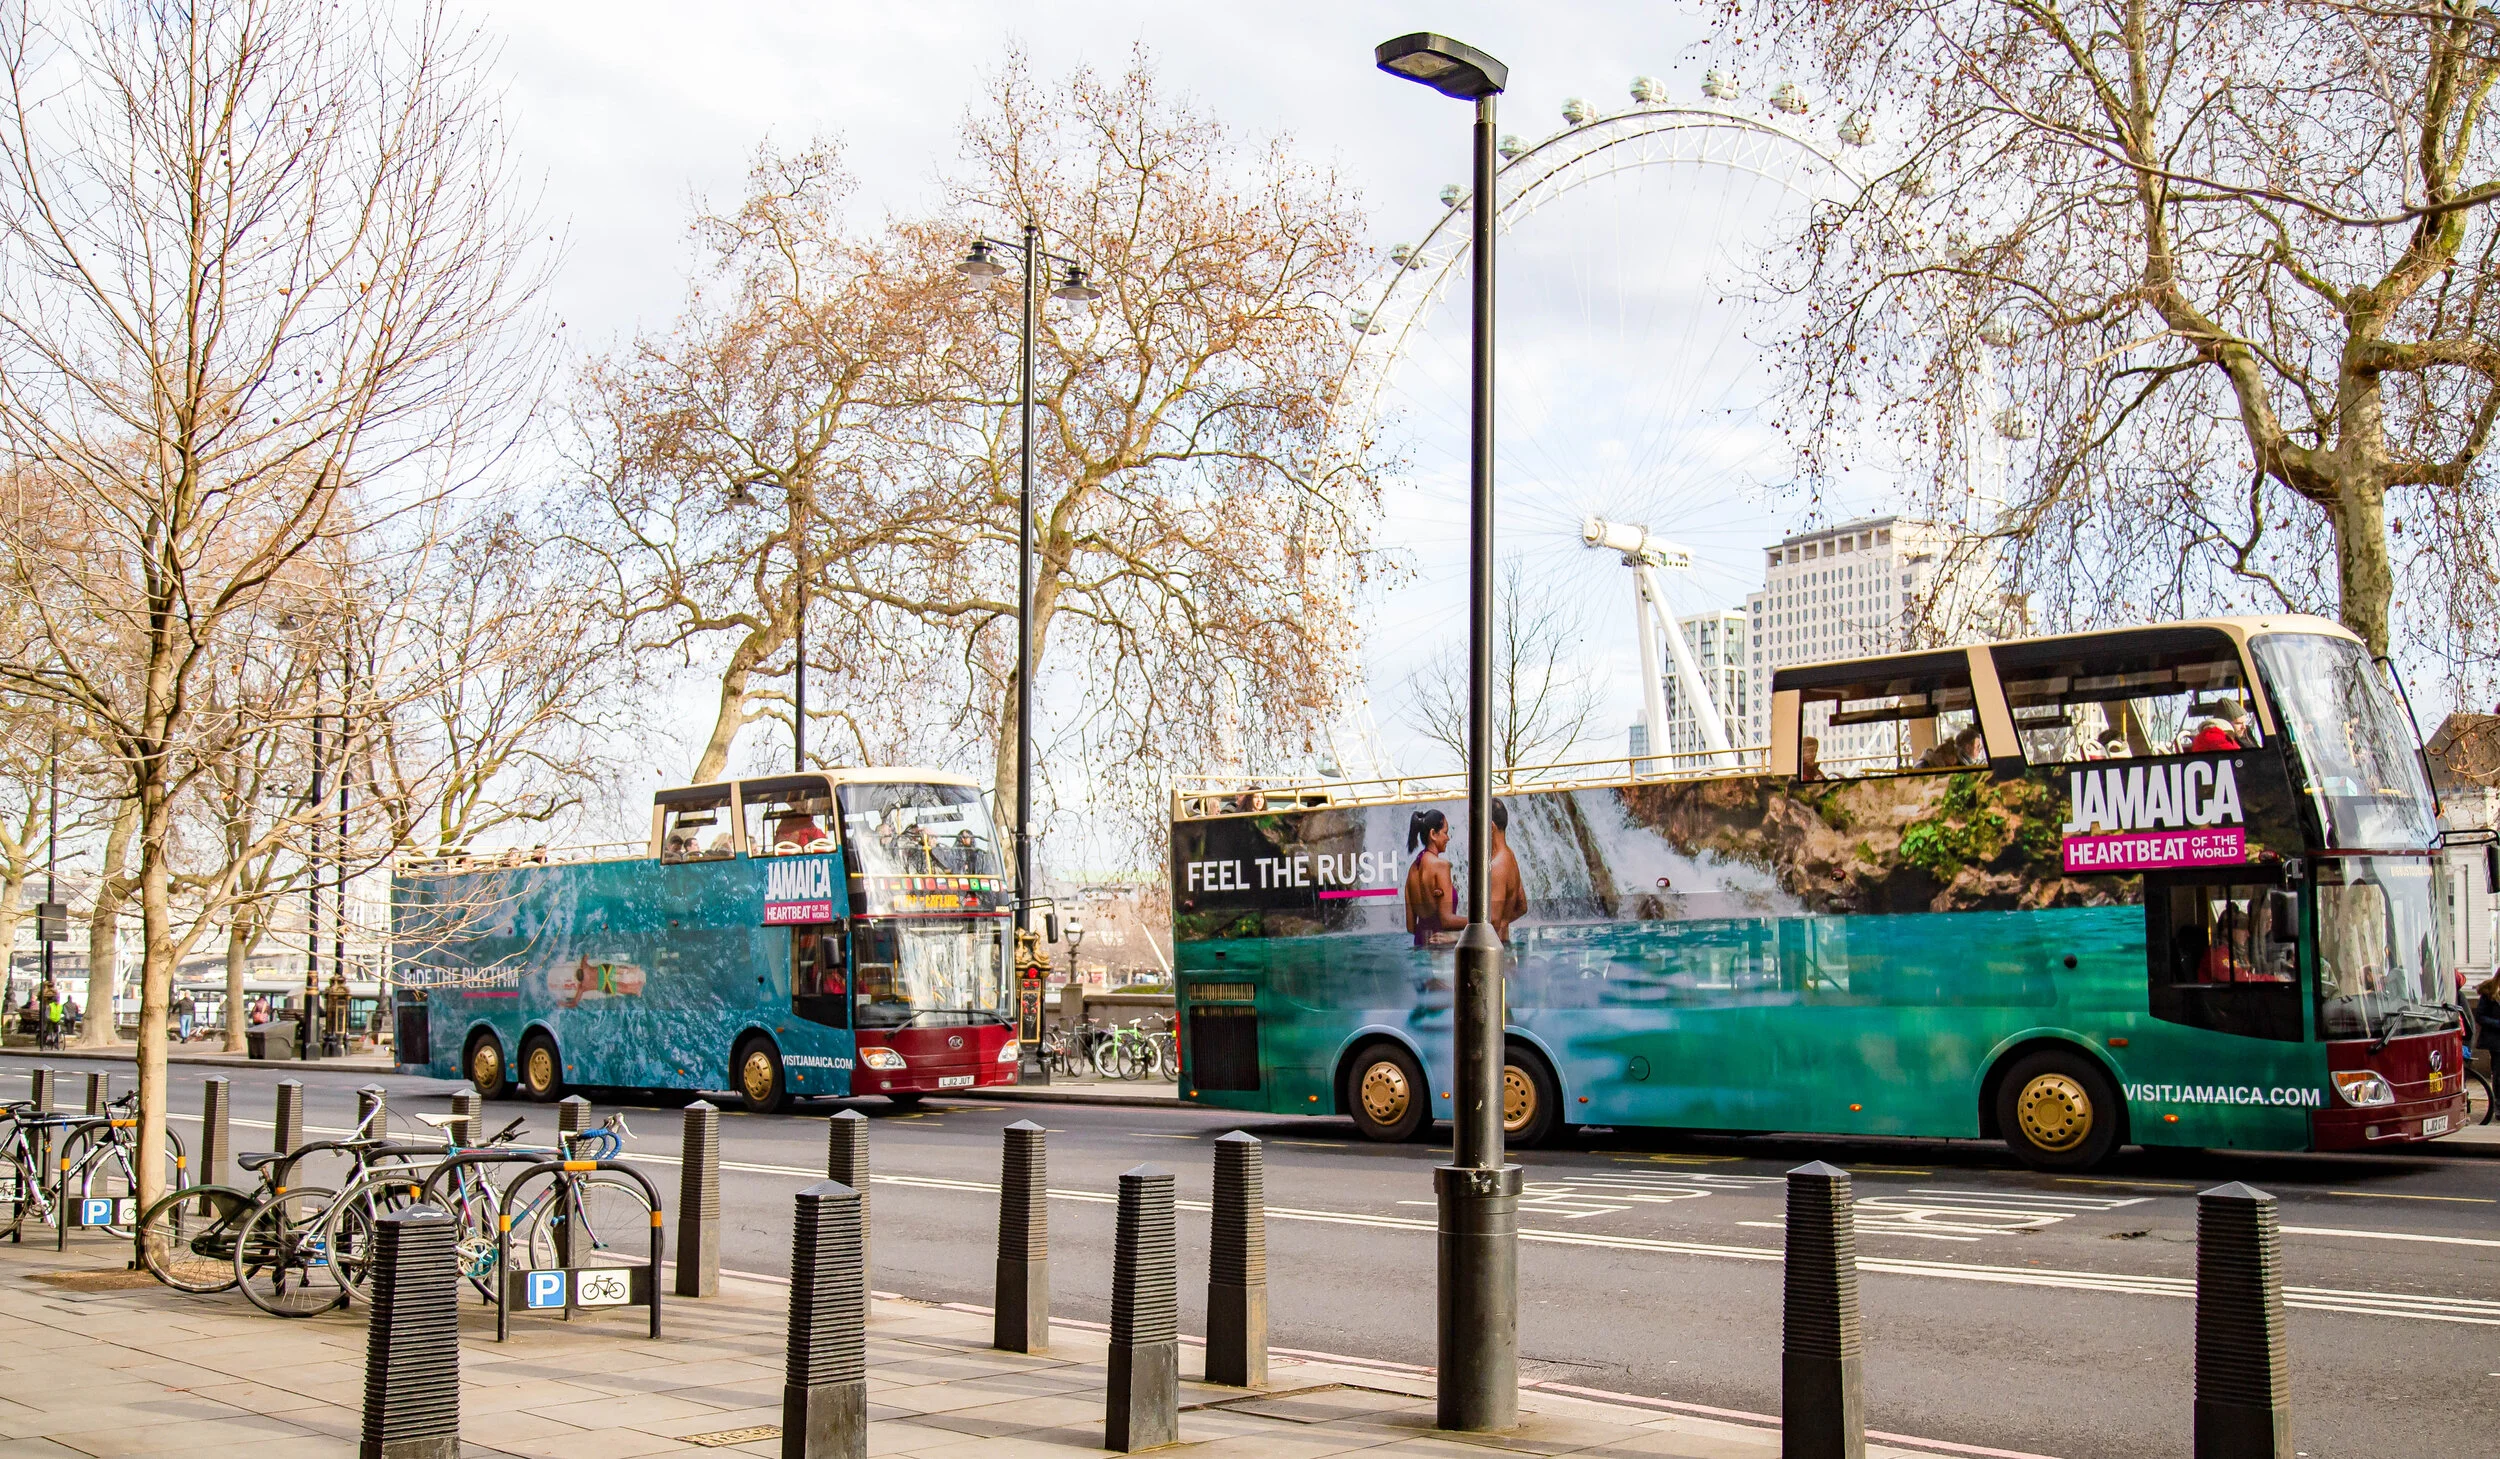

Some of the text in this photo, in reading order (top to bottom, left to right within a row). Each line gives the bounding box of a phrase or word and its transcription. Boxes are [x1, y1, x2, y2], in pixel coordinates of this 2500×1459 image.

[2062, 759, 2244, 833] JAMAICA
[2069, 834, 2238, 866] HEARTBEAT OF THE
[2192, 846, 2238, 859] WORLD
[765, 858, 832, 900] JAMAICA
[1187, 850, 1398, 892] FEEL THE RUSH
[767, 905, 811, 920] HEARTBEAT
[434, 967, 460, 989] THE
[462, 965, 519, 988] RHYTHM
[781, 1054, 853, 1070] VISITJAMAICA.COM
[2122, 1083, 2321, 1107] VISITJAMAICA.COM
[87, 1200, 108, 1224] P
[535, 1274, 561, 1305] P
